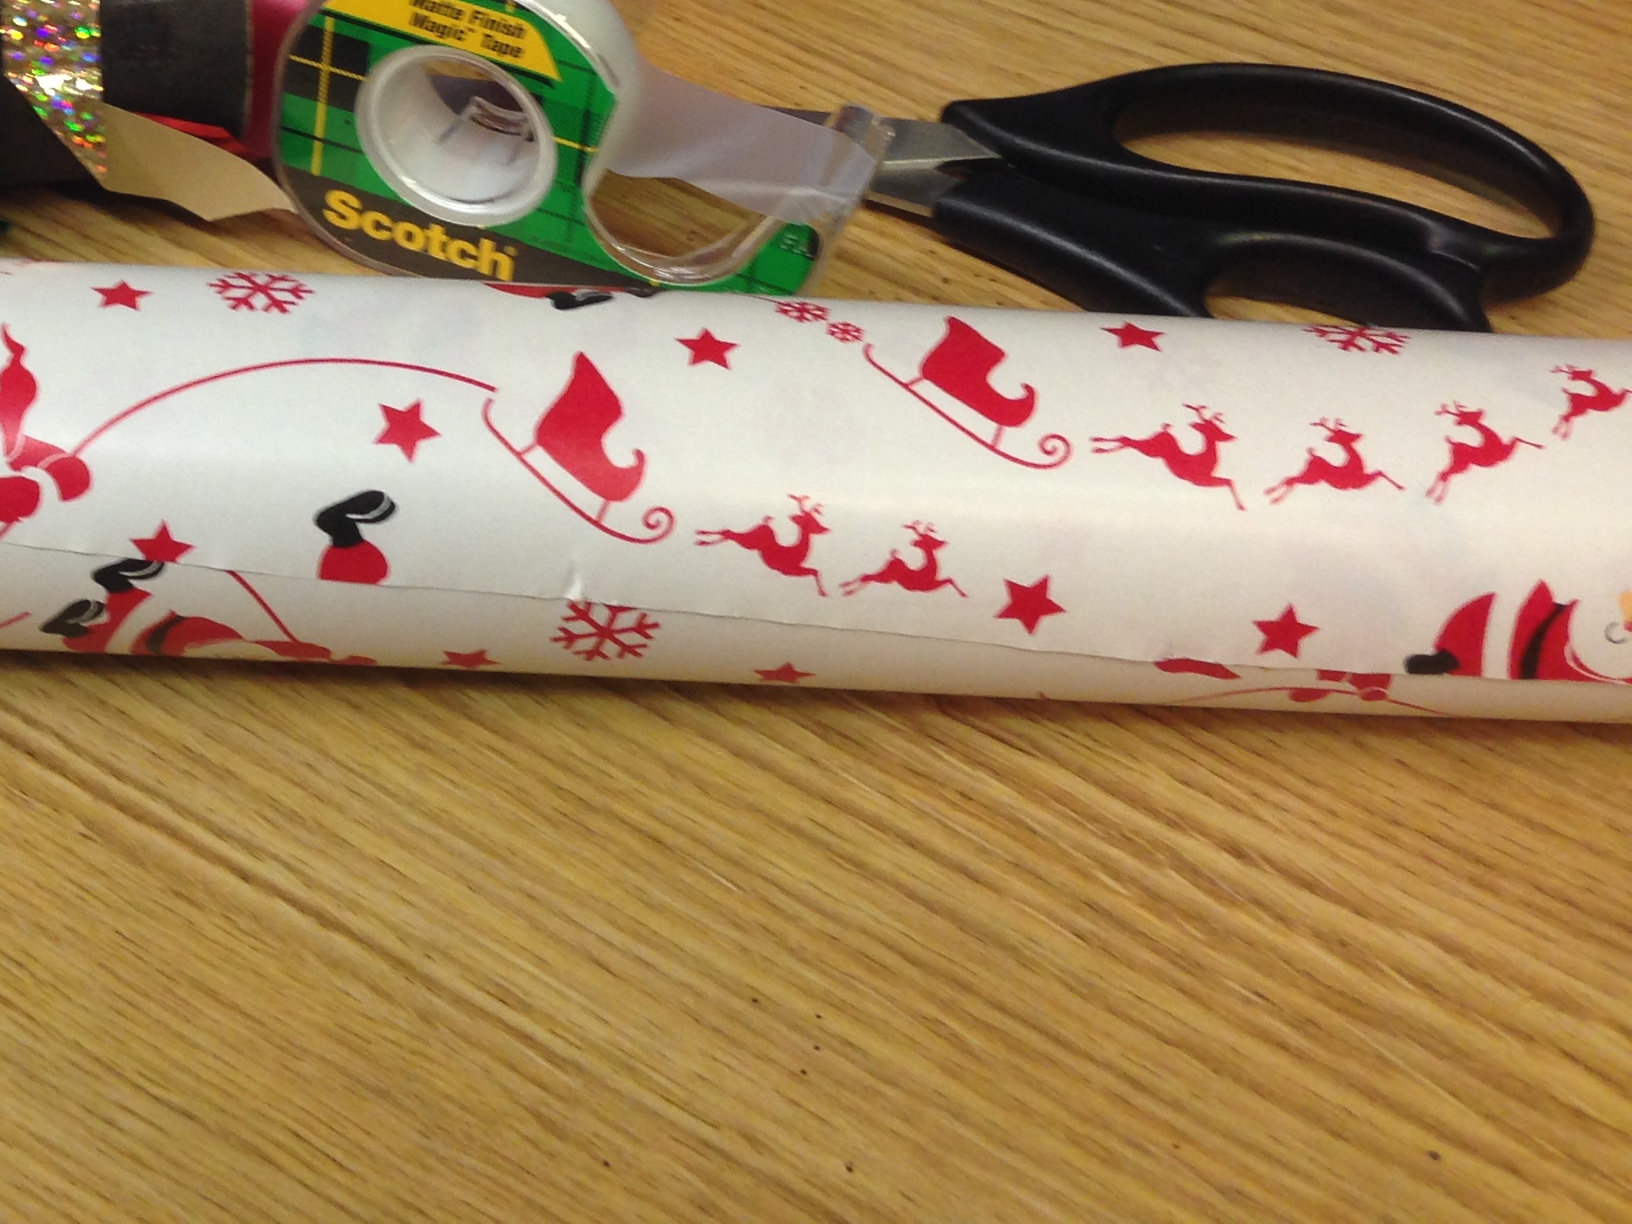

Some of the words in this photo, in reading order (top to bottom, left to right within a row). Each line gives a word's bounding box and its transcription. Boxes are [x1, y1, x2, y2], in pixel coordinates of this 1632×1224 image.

[408, 10, 466, 42] Magic
[480, 31, 524, 58] Tape
[468, 8, 527, 40] Finish
[322, 188, 515, 282] Scotch
